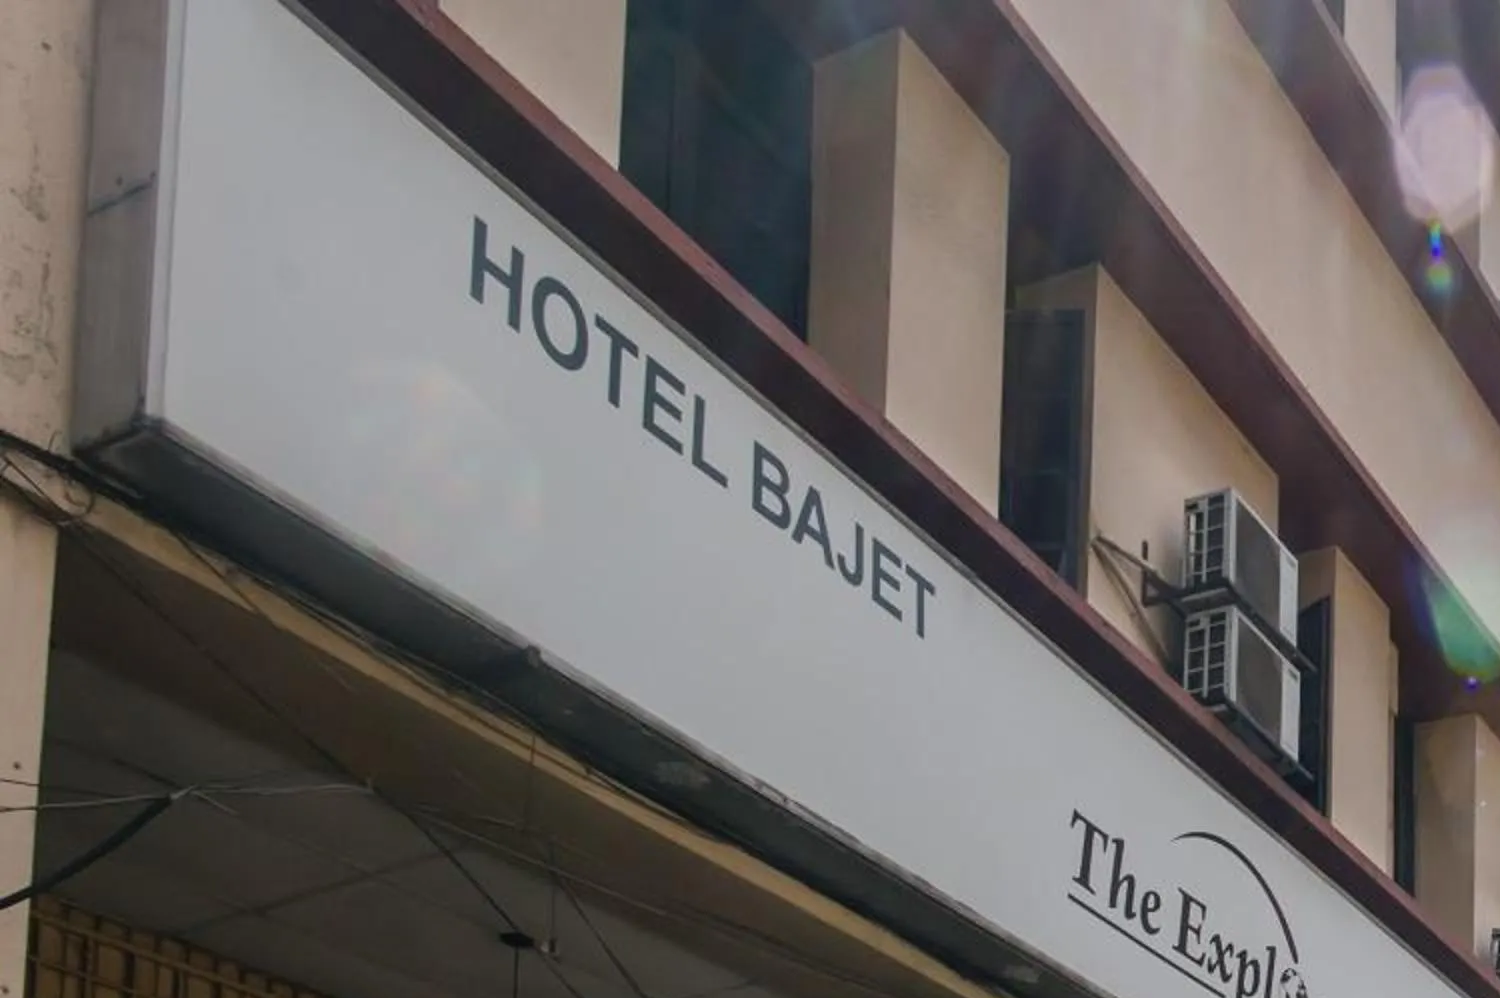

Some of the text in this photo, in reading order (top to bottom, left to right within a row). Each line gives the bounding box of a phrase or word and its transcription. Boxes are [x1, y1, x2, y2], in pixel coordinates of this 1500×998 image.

[469, 215, 936, 639] HOTEL BAJET
[1070, 808, 1162, 935] The
